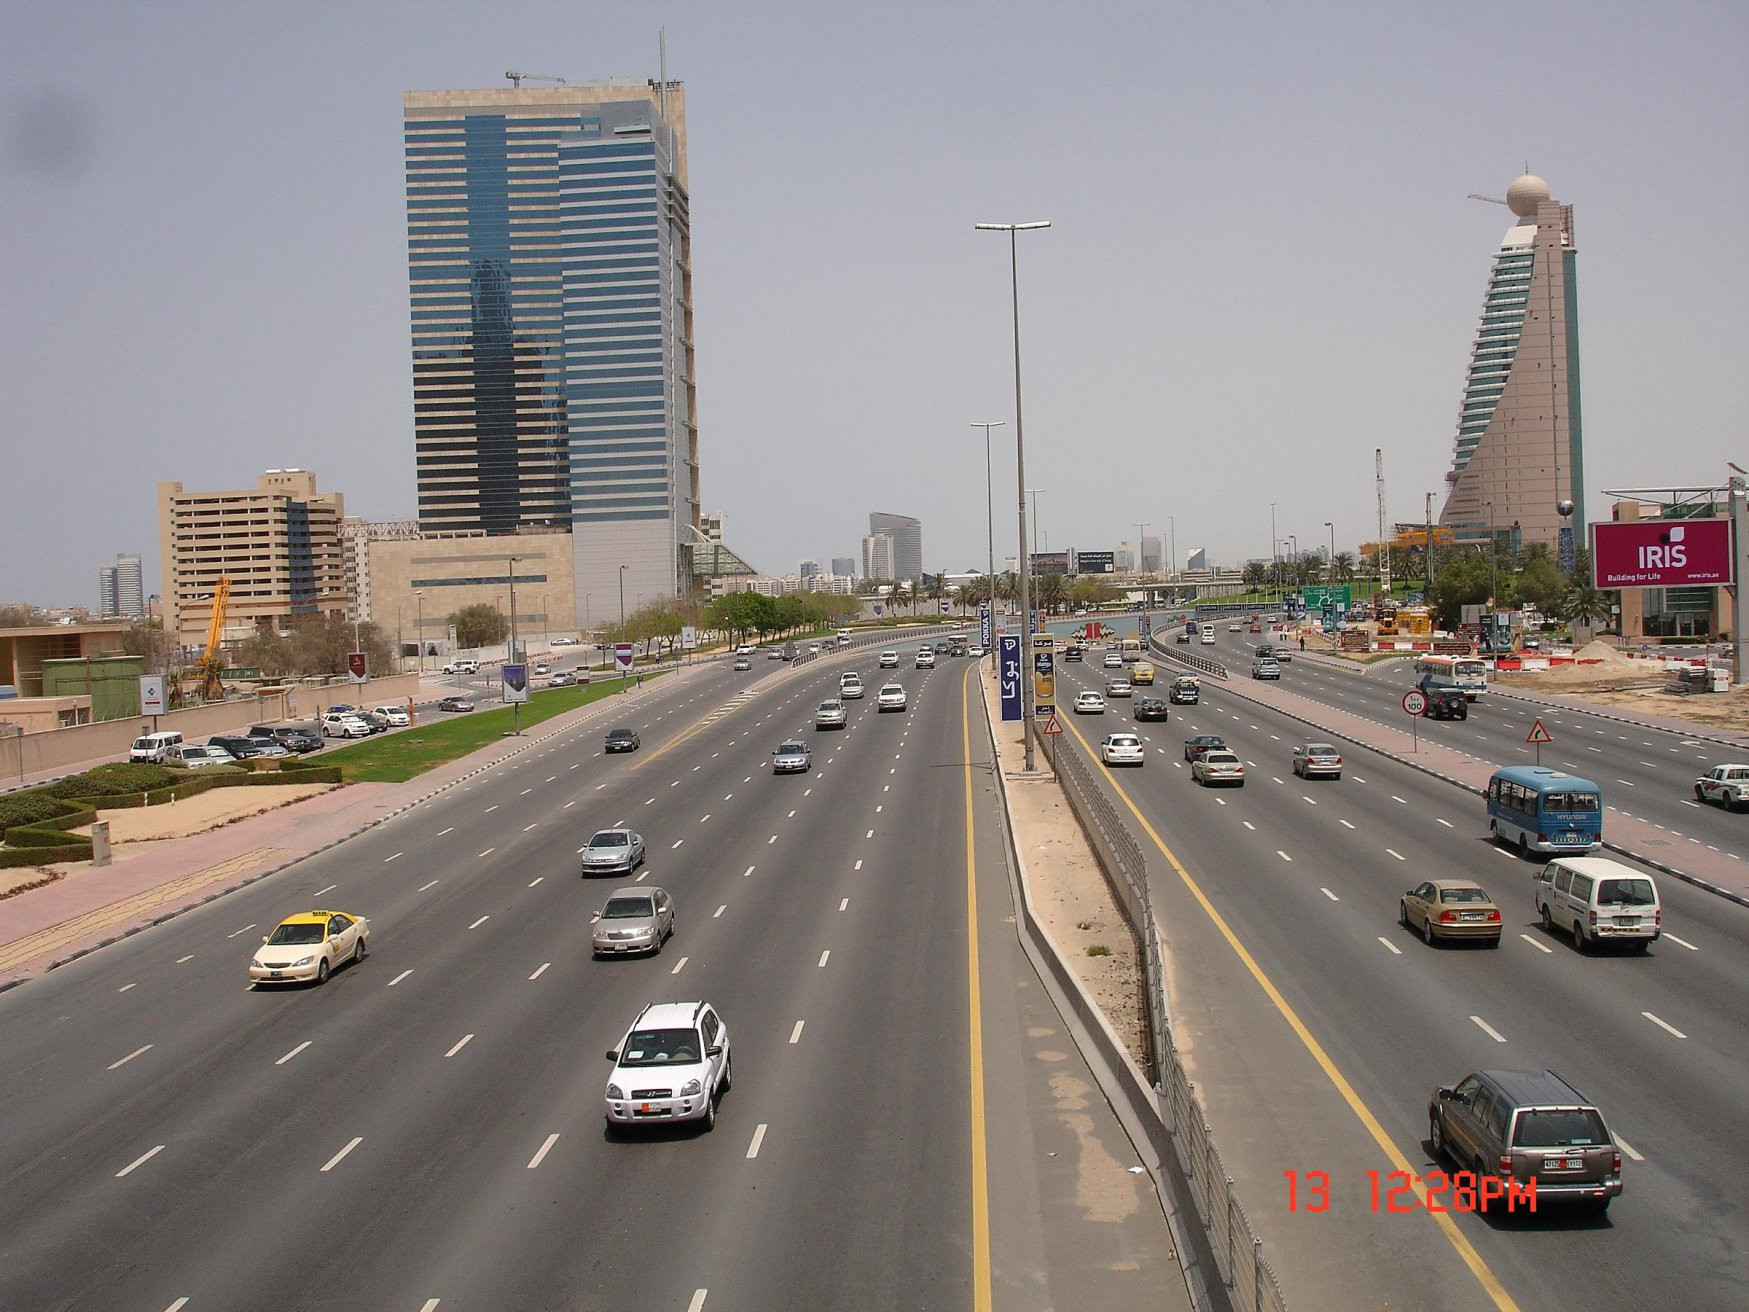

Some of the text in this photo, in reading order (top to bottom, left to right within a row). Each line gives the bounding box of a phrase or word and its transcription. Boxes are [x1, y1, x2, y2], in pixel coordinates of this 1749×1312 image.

[1638, 545, 1687, 569] IRIS
[1607, 574, 1636, 582] Building
[982, 617, 990, 645] POKKA
